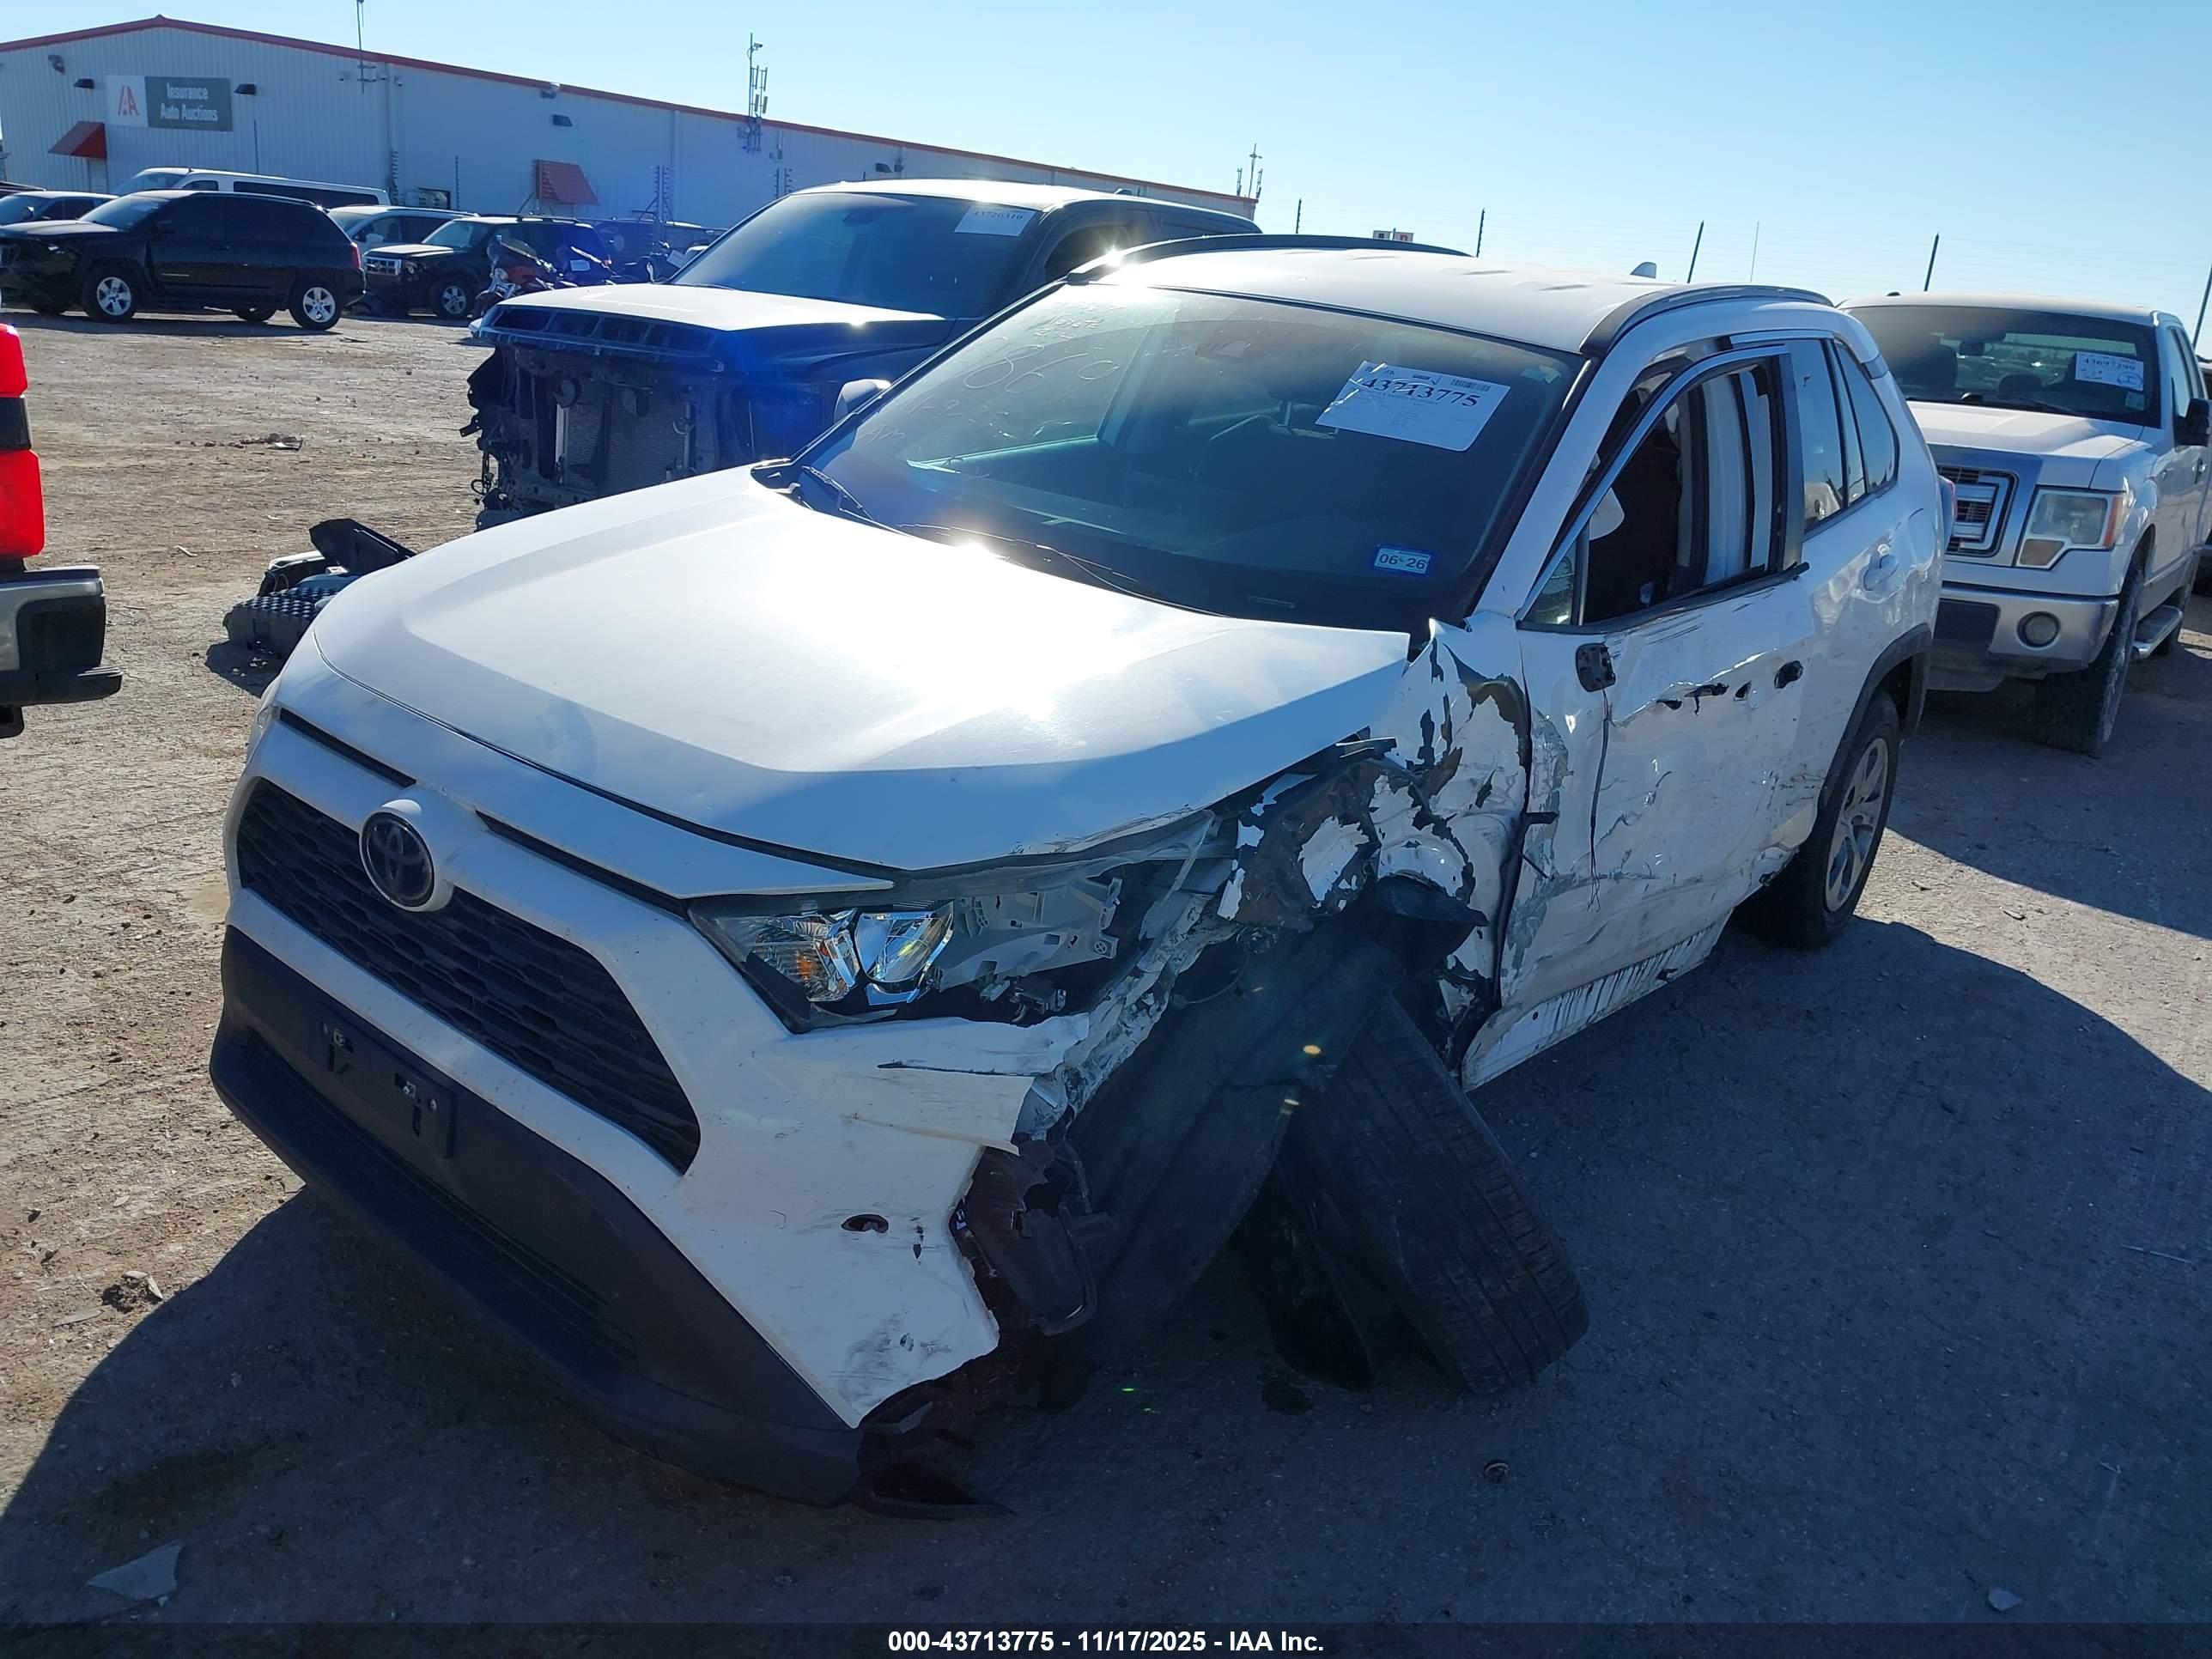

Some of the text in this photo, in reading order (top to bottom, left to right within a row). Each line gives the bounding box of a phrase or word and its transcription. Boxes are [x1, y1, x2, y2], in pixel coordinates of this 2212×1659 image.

[166, 82, 209, 100] Insurance
[161, 103, 218, 122] Auto Auctions
[1363, 378, 1481, 407] 43713775
[1406, 558, 1426, 569] 26
